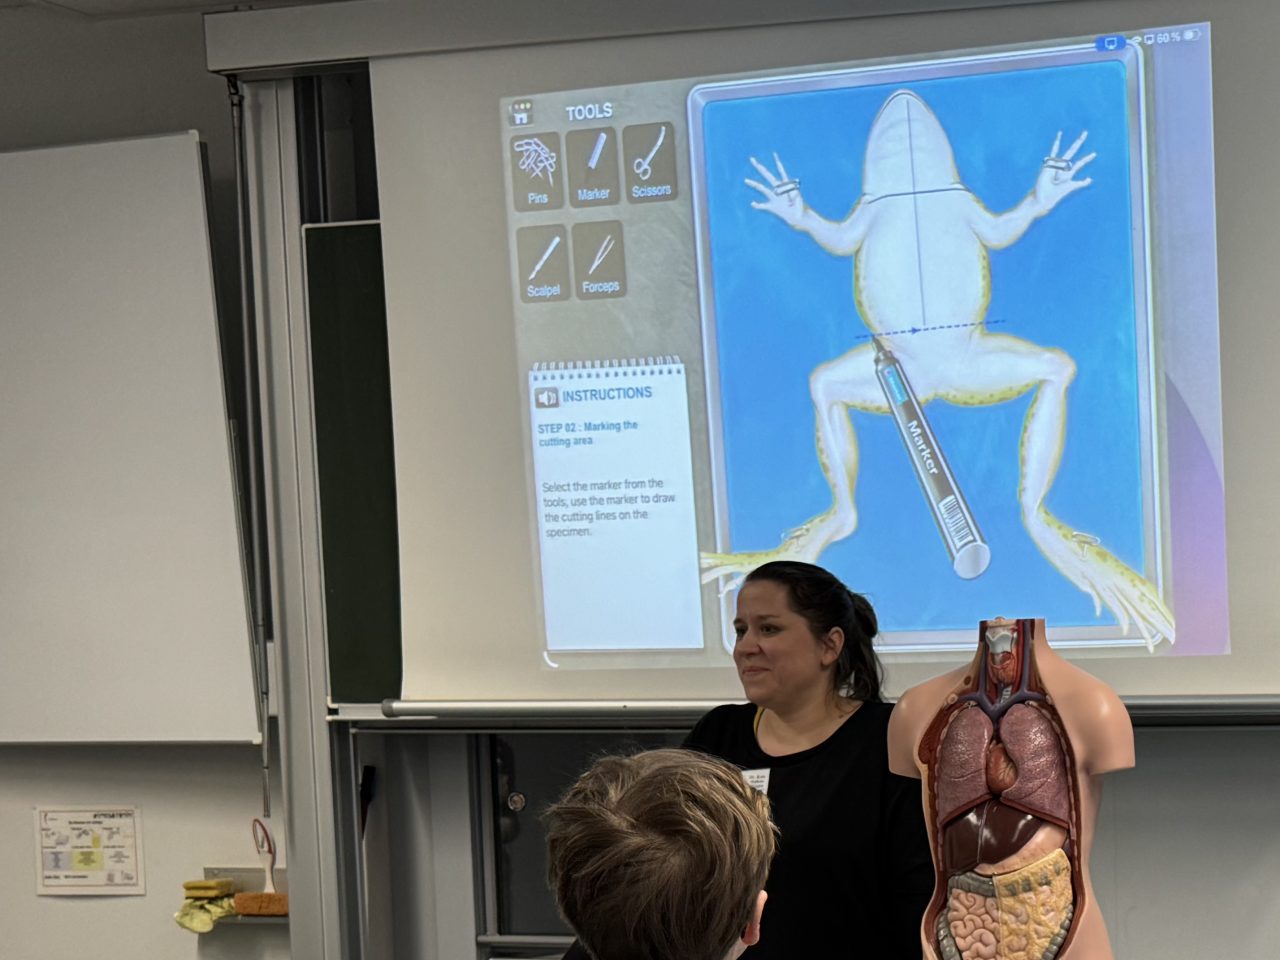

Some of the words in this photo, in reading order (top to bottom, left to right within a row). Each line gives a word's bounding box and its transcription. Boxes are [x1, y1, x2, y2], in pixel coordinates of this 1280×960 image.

[566, 102, 613, 121] TOOLS
[528, 192, 548, 204] Pins
[578, 188, 610, 201] Marker
[632, 185, 672, 198] Scissors
[527, 285, 561, 298] Scalpel
[582, 281, 621, 294] Forceps
[562, 386, 653, 402] INSTRUCTIONS
[538, 423, 563, 434] STEP
[565, 422, 577, 433] 02
[584, 421, 621, 433] Marking
[623, 420, 638, 430] the
[539, 438, 571, 449] cutting
[573, 437, 593, 446] area
[907, 420, 939, 476] Marker
[542, 482, 571, 493] Select
[573, 481, 588, 491] the
[590, 479, 622, 490] marker
[624, 479, 646, 489] from
[648, 478, 664, 488] the
[543, 497, 569, 509] tools,
[571, 498, 588, 507] use
[589, 496, 605, 506] the
[606, 494, 638, 505] marker
[641, 494, 650, 504] to
[652, 493, 675, 503] draw
[545, 513, 560, 523] the
[561, 511, 594, 523] cutting
[595, 510, 617, 520] lines
[619, 511, 631, 520] on
[633, 510, 649, 520] the
[546, 527, 593, 538] specimen.
